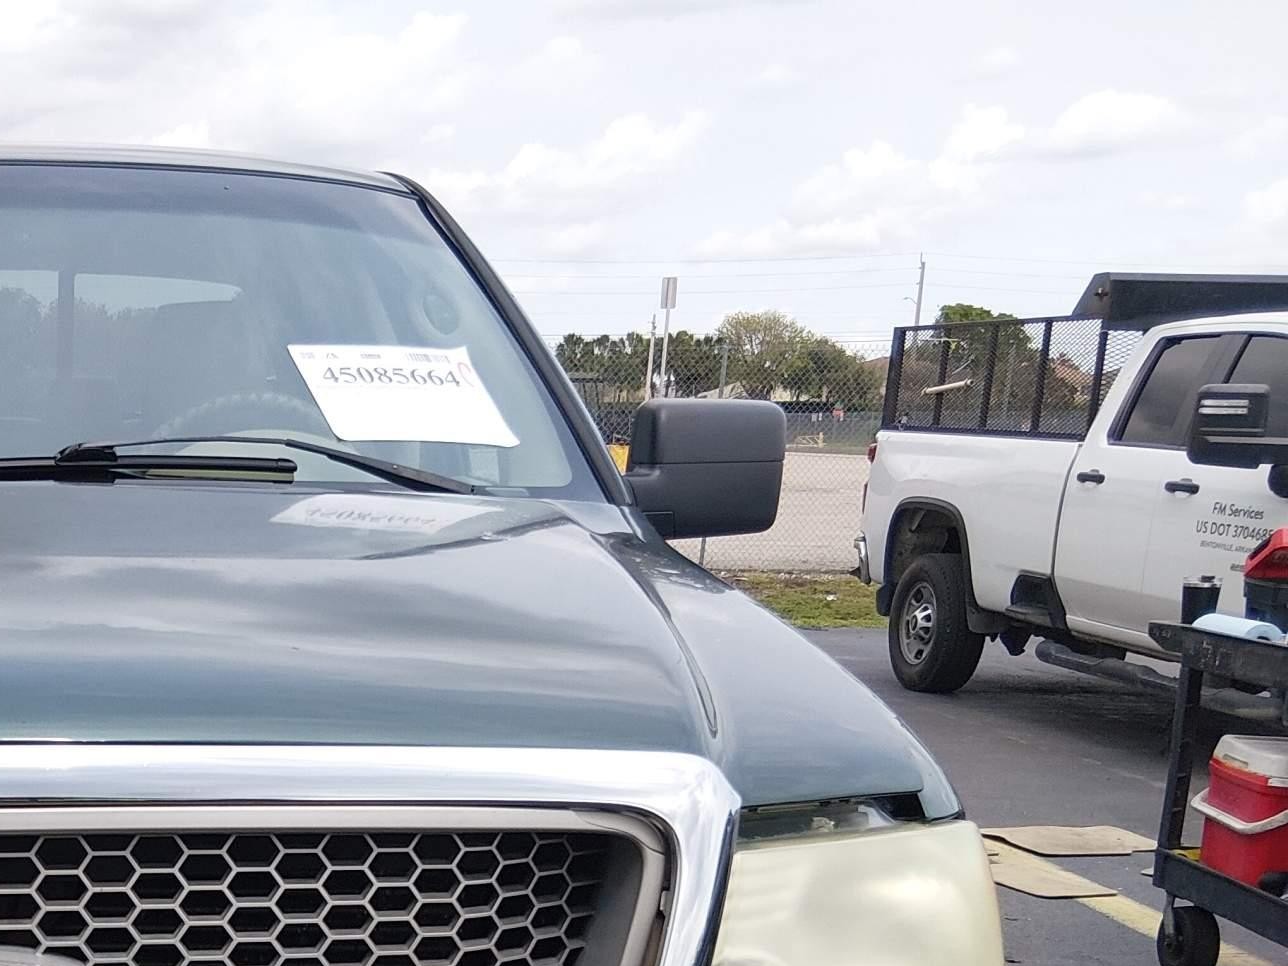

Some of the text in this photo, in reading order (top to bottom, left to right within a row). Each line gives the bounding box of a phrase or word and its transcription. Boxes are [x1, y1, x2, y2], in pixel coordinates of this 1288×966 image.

[321, 366, 460, 388] 45085664
[1212, 502, 1265, 520] FM Services
[1196, 520, 1209, 534] US
[1210, 522, 1232, 537] DOT
